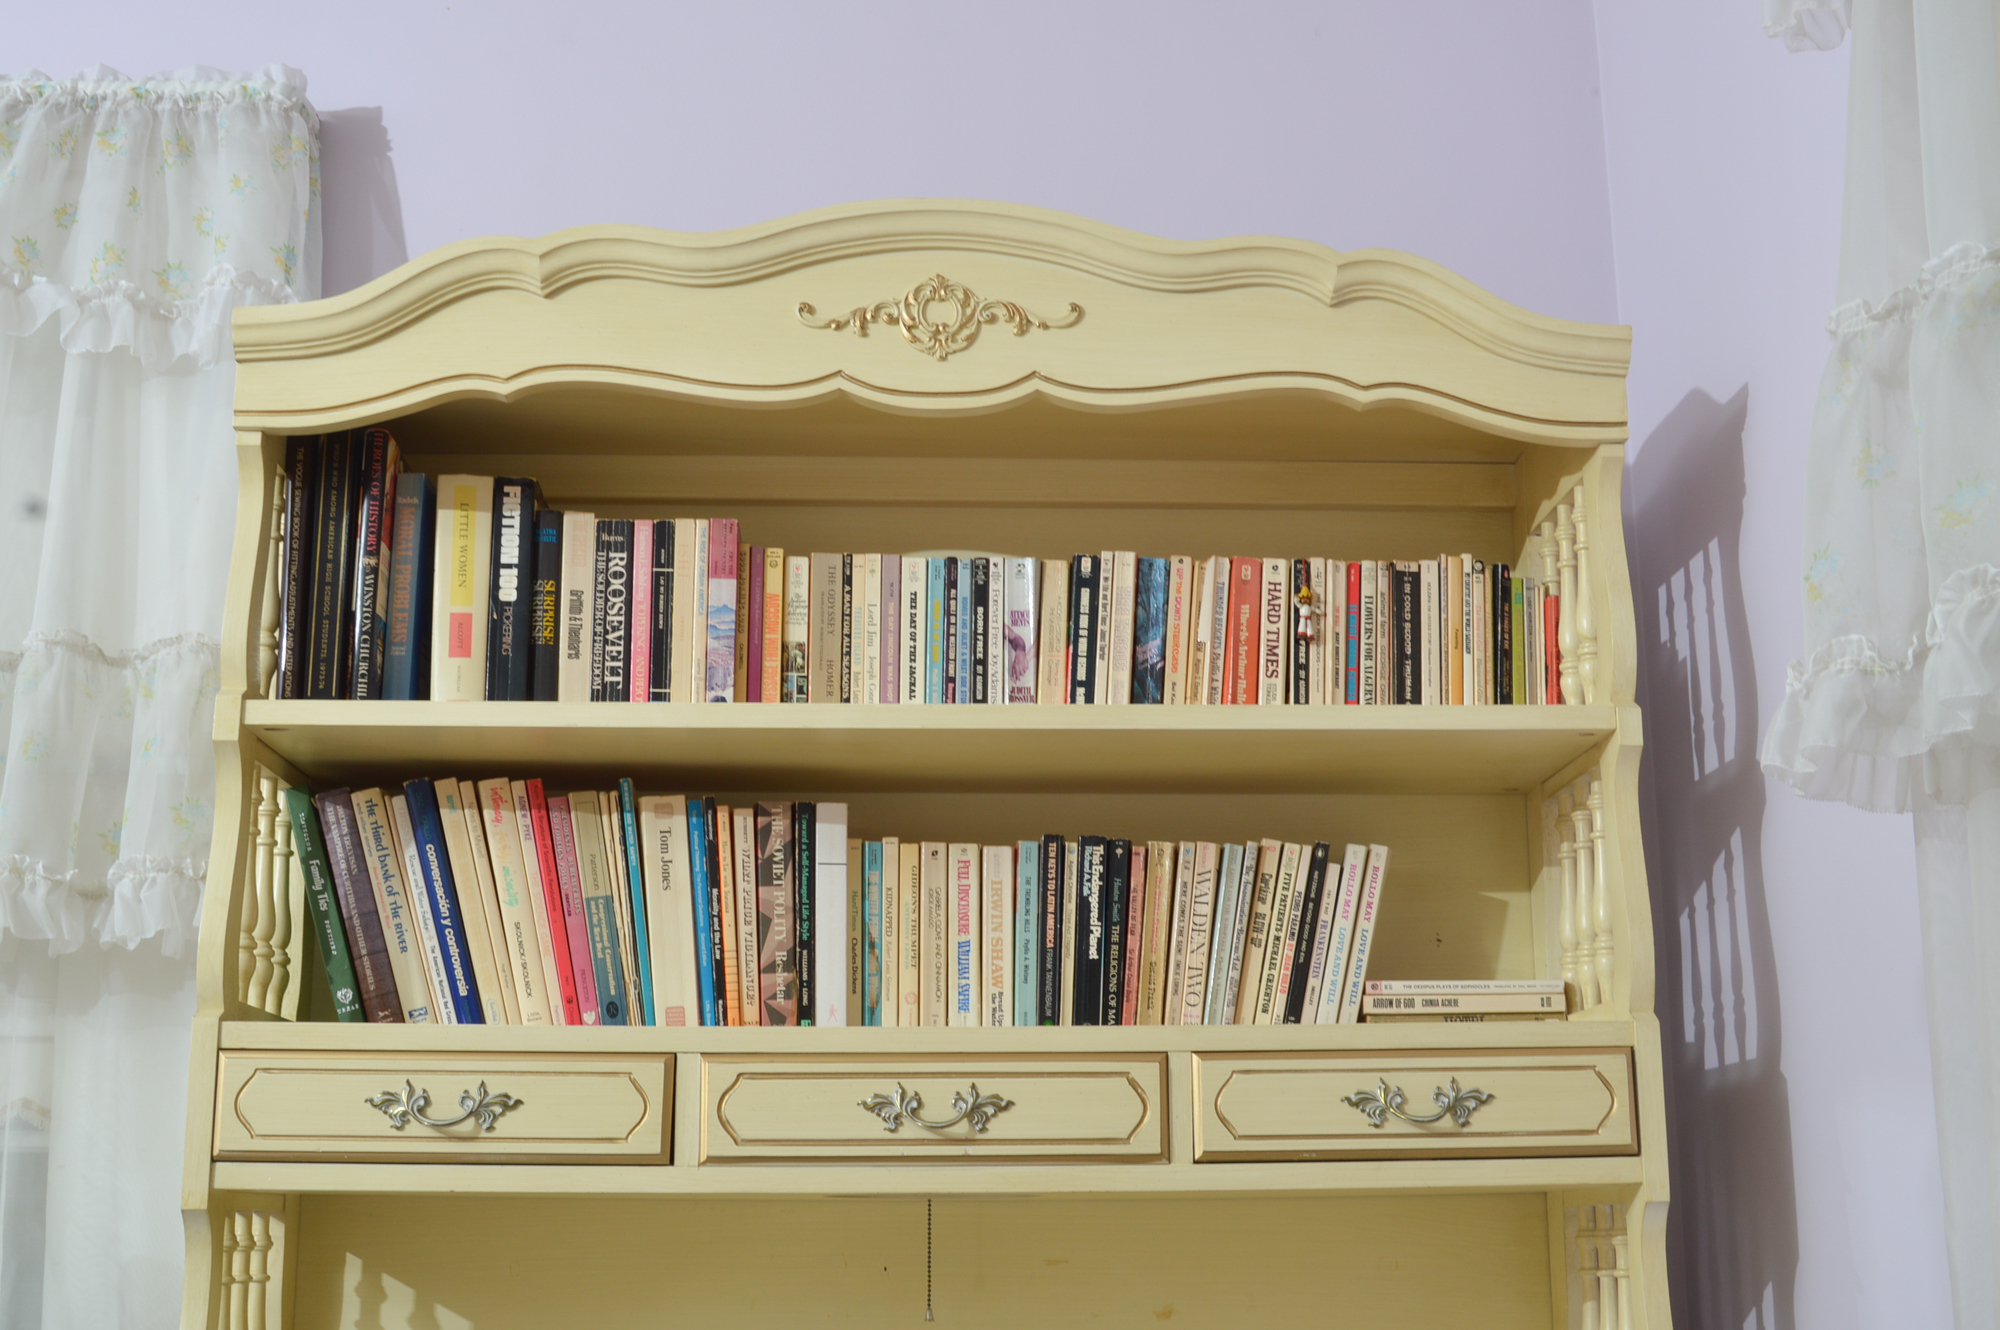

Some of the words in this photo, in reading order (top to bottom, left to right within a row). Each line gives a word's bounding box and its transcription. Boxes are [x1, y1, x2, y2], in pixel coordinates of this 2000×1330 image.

[371, 433, 384, 479] HEROES
[370, 481, 380, 498] OF
[366, 501, 379, 553] HISTORY
[395, 506, 416, 560] MORAL
[459, 503, 470, 541] LITTLE
[500, 485, 521, 565] FICTION
[457, 545, 469, 589] WOMEN
[596, 550, 606, 573] THE
[827, 565, 837, 586] THE
[498, 567, 518, 602] 100
[595, 573, 606, 620] SOLDIER
[1404, 583, 1412, 594] IN
[361, 574, 375, 631] WINSTON
[391, 564, 412, 642] PROBLEMS
[766, 593, 781, 635] MOSCOW
[826, 588, 837, 638] ODYSSEY
[843, 594, 851, 615] MAN
[867, 604, 878, 627] Lord
[910, 591, 918, 612] THE
[961, 597, 969, 618] ROMEO
[990, 589, 1001, 626] Forever
[1266, 581, 1282, 625] HARD
[1380, 590, 1389, 619] animal
[1404, 595, 1412, 621] COLD
[502, 606, 513, 655] PICKERING
[594, 620, 604, 636] OF
[603, 551, 627, 690] ROOSEVELT
[843, 616, 851, 636] FOR
[1239, 604, 1250, 641] Wheels
[1364, 595, 1375, 641] FLOWERS
[1380, 620, 1388, 639] farm
[765, 637, 779, 662] FROM
[867, 629, 877, 648] Jim
[909, 632, 917, 643] OF
[976, 635, 984, 660] FREE
[991, 627, 1000, 650] Free
[1364, 642, 1374, 662] FOR
[1404, 622, 1412, 655] BLOOD
[592, 637, 603, 690] FREEDOM
[866, 655, 877, 681] Joseph
[909, 645, 917, 664] THE
[990, 654, 1000, 668] Joy
[1238, 644, 1249, 676] Arthur
[1265, 628, 1280, 679] TIMES
[825, 659, 836, 698] HOMER
[842, 655, 850, 699] SEASONS
[909, 665, 917, 701] JACKAL
[1403, 659, 1412, 700] TRUMAN
[771, 805, 785, 835] THE
[801, 813, 809, 844] Toward
[336, 805, 349, 835] DALTON
[343, 835, 358, 876] TREVISAN
[659, 826, 672, 855] Tom
[1048, 842, 1057, 858] TEN
[1092, 844, 1104, 866] This
[590, 853, 600, 891] Patterson
[660, 856, 674, 892] Jones
[772, 837, 786, 889] SOVIET
[1047, 858, 1057, 879] KEYS
[1083, 845, 1092, 873] Richard
[308, 859, 325, 891] Family
[317, 892, 330, 912] Ties
[425, 843, 452, 917] conversación
[800, 851, 810, 903] Self-Managed
[910, 864, 919, 915] GIDEON'S
[1047, 879, 1056, 890] TO
[1113, 877, 1122, 901] Huston
[1282, 872, 1293, 892] FIVE
[1310, 869, 1320, 899] NIETZSCHE
[1346, 862, 1358, 898] ROLLO
[1368, 864, 1381, 900] ROLLO
[711, 888, 721, 916] Morality
[851, 890, 859, 909] Hard
[990, 879, 1004, 934] IRWIN
[1046, 890, 1056, 913] LATIN
[1088, 865, 1103, 926] Endangered
[1341, 898, 1352, 922] MAY
[438, 916, 451, 926] y
[773, 891, 787, 943] POLITY
[802, 904, 810, 920] Life
[851, 909, 859, 932] Times
[1112, 902, 1121, 922] Smith
[1190, 868, 1212, 956] WALDEN
[1275, 893, 1289, 934] PATIENTS
[1306, 901, 1314, 924] BEYOND
[1363, 900, 1374, 924] MAY
[801, 921, 810, 941] Style
[910, 917, 919, 970] TRUMPET
[1046, 913, 1055, 949] AMERICA
[1088, 925, 1101, 960] Planet
[1110, 924, 1121, 943] THE
[1336, 926, 1347, 954] LOVE
[1358, 927, 1369, 956] LOVE
[444, 927, 469, 997] controversia
[596, 942, 604, 959] Deal
[598, 899, 610, 948] Congressional
[605, 949, 617, 996] Conservatism
[714, 944, 722, 960] Law
[851, 937, 859, 966] Charles
[957, 939, 971, 982] WILLIAM
[990, 936, 1004, 989] SHAW
[1268, 935, 1282, 972] MICHAEL
[1311, 919, 1329, 981] FRANKENSTEIN
[775, 950, 788, 1005] Reshetar
[851, 966, 859, 995] Dickens
[1108, 944, 1120, 993] RELIGIONS
[1331, 953, 1342, 978] AND
[1353, 955, 1365, 980] AND
[957, 982, 971, 1014] SAFIRE
[1045, 971, 1053, 1018] TANNENBAUM
[1185, 961, 1204, 1007] TWO
[1261, 973, 1276, 1016] CRICHTON
[1326, 978, 1339, 1006] WILL
[1348, 979, 1360, 1007] WILL
[1107, 993, 1117, 1008] OF
[1373, 998, 1394, 1009] ARROW
[1395, 998, 1402, 1008] OF
[1403, 998, 1415, 1009] GOD
[1421, 998, 1440, 1007] CHINUA
[1441, 998, 1459, 1007] ACHEBE
